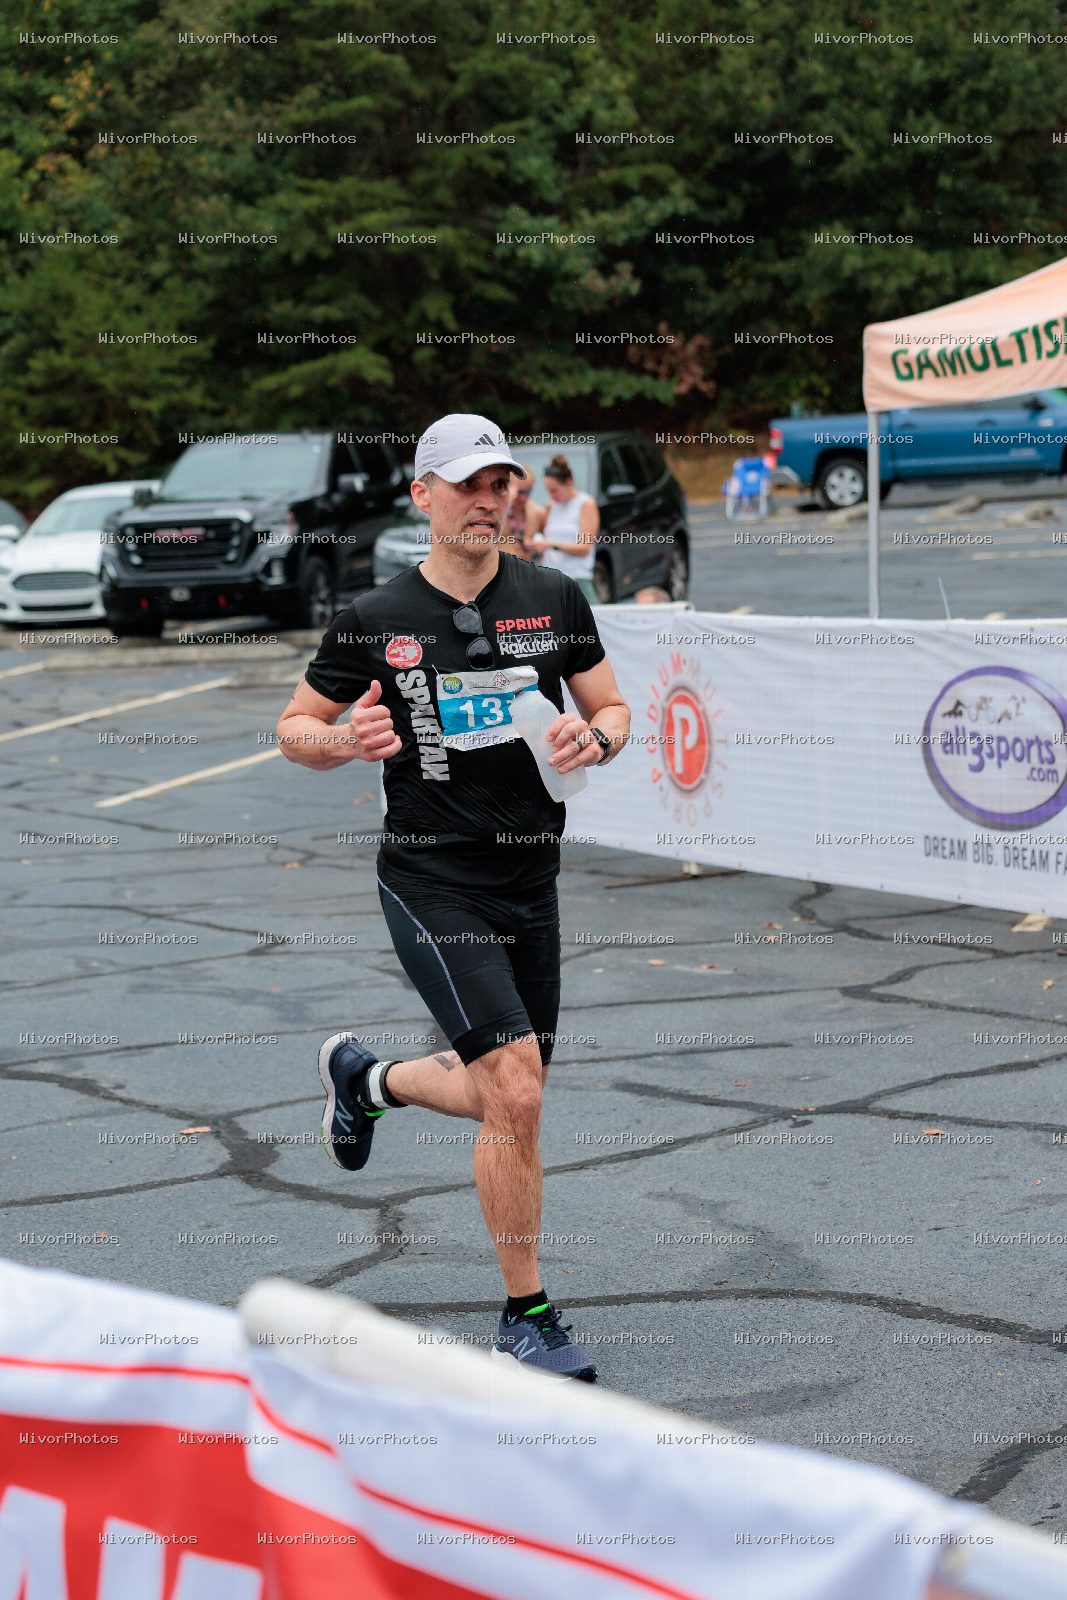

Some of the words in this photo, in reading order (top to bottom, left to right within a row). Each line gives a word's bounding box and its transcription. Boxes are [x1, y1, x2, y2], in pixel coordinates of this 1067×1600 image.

[891, 313, 1067, 381] GAMULTIS
[495, 615, 552, 633] SPRINT
[499, 638, 559, 656] Rakuten
[395, 669, 450, 782] SPARTAN
[459, 697, 513, 729] 13
[941, 725, 1056, 773] all3sports
[1026, 766, 1060, 784] .com
[923, 834, 968, 863] DREAM
[972, 842, 998, 866] BIG.
[1003, 844, 1050, 873] DREAM
